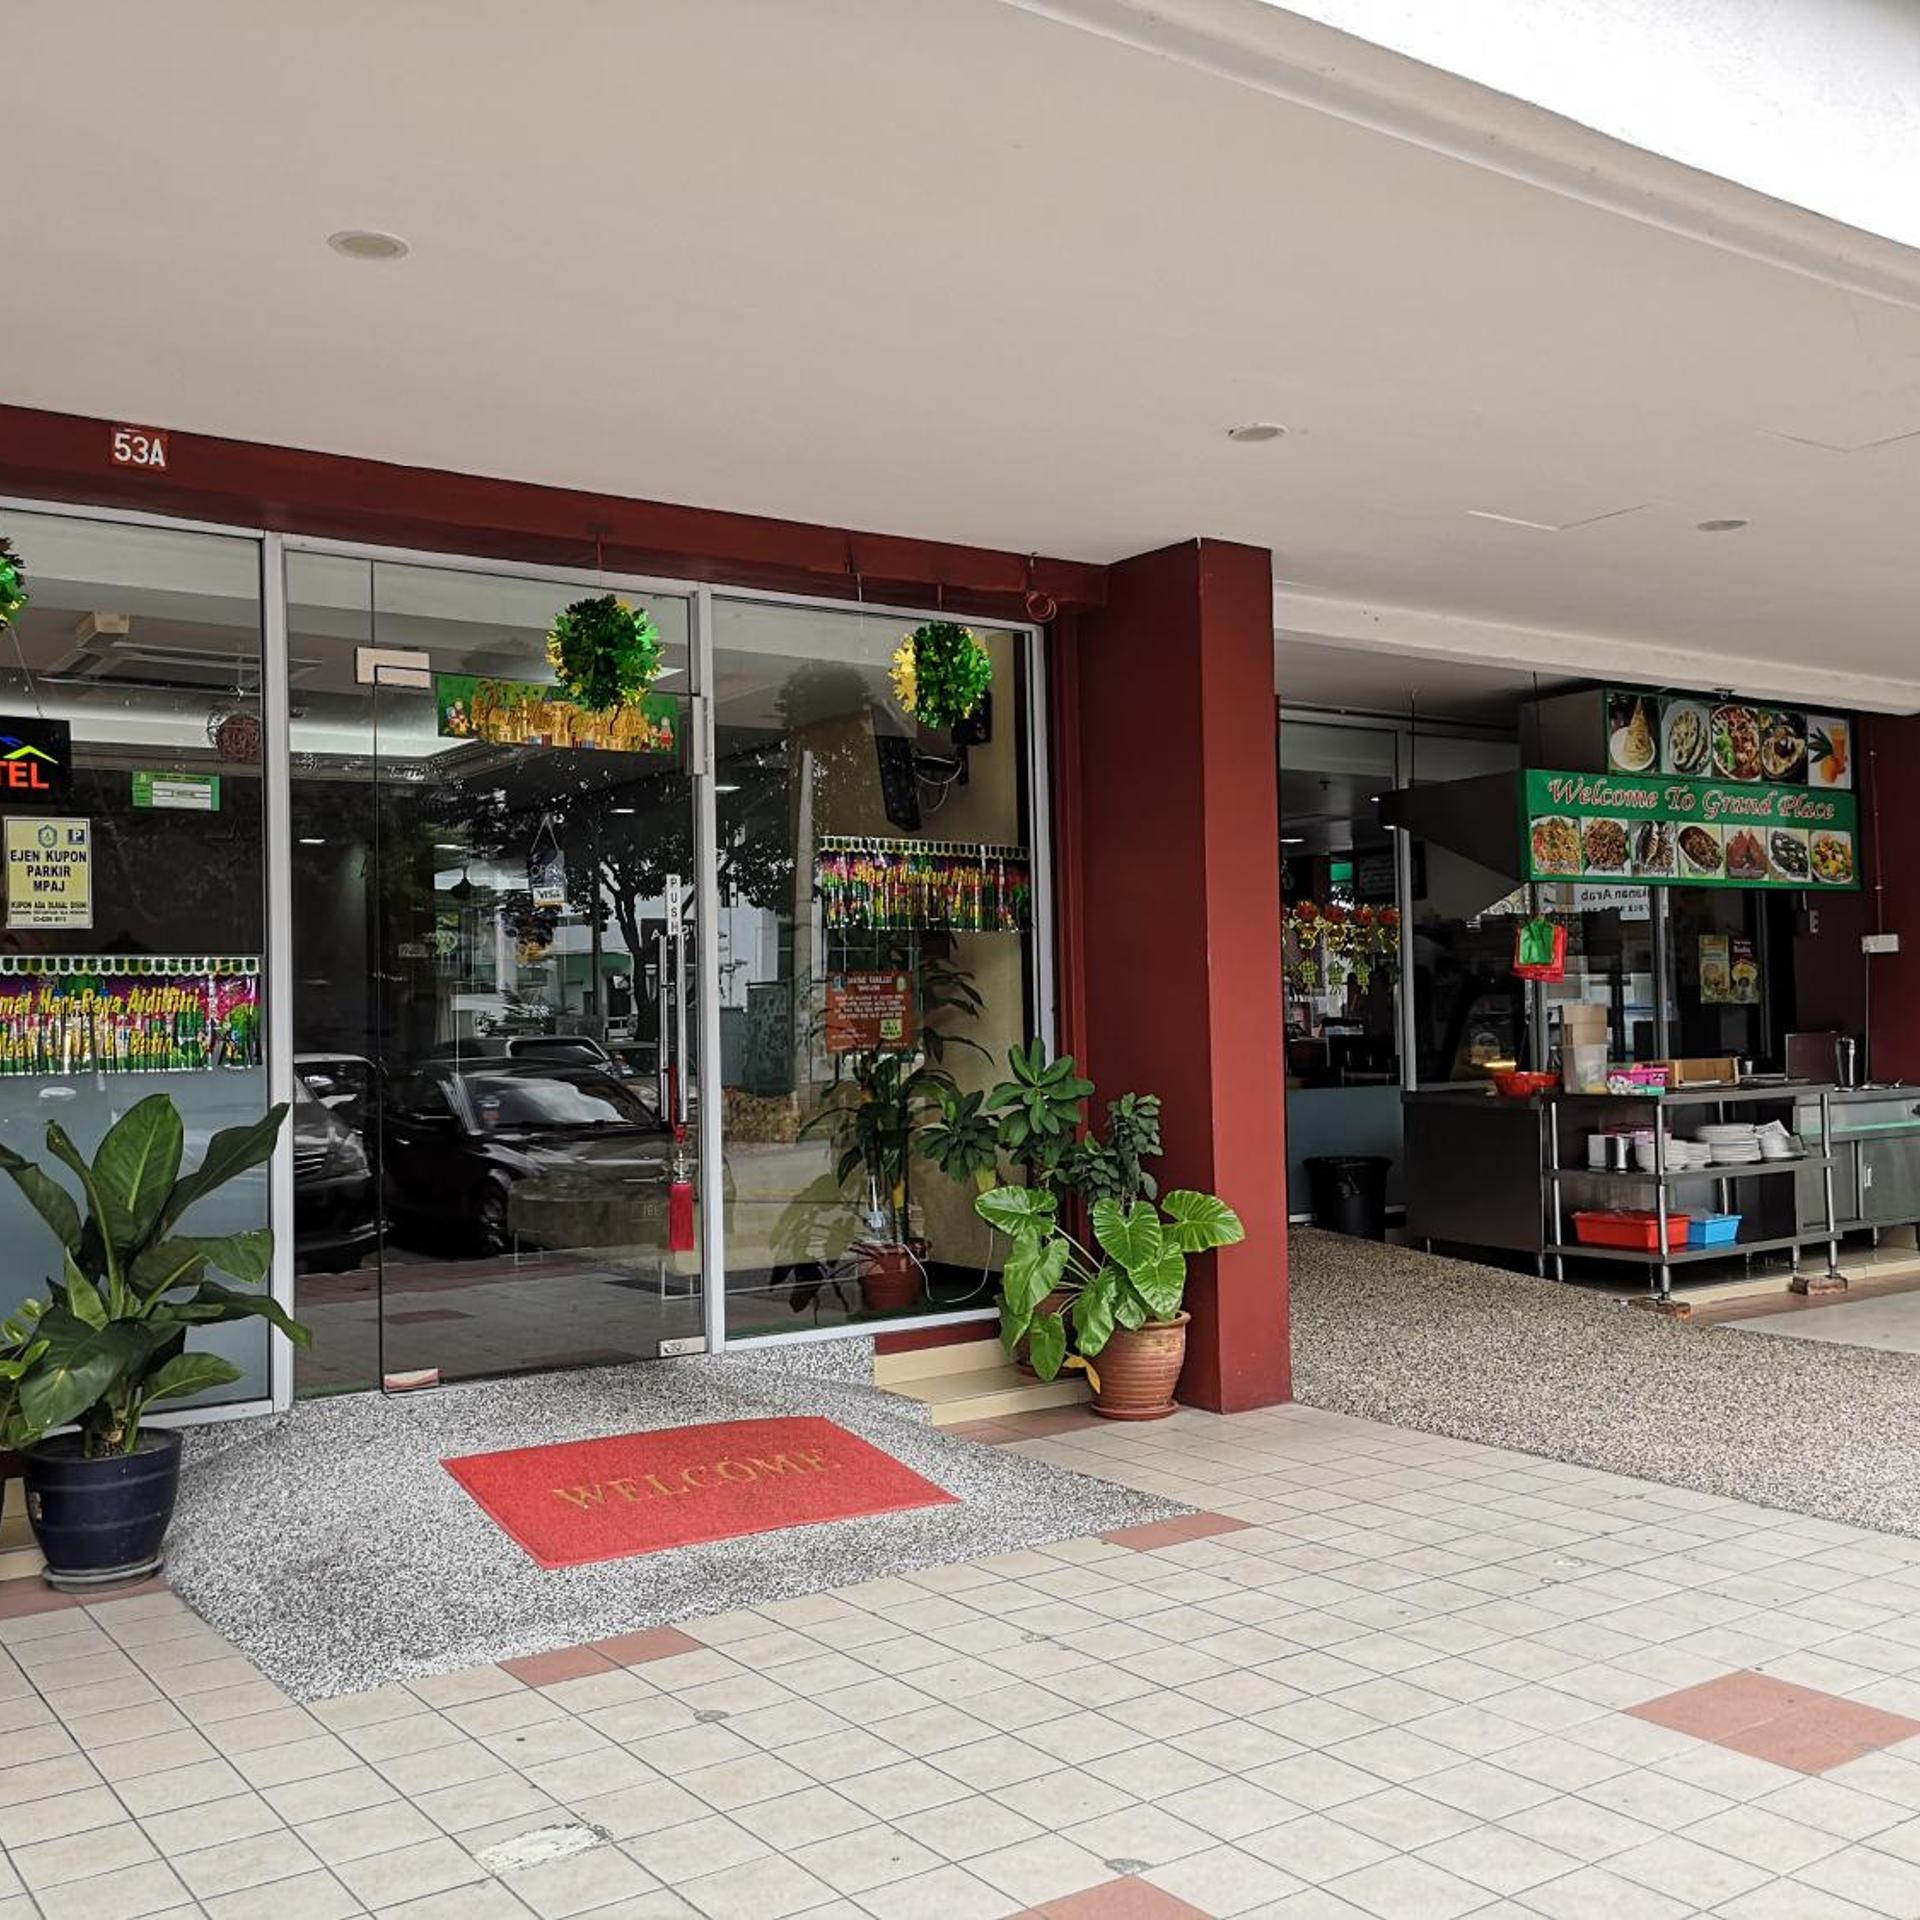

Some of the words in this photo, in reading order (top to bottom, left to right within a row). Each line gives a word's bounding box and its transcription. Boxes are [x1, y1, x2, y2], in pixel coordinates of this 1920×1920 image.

[114, 432, 166, 467] 53A
[1547, 777, 1658, 810] Welcome
[1664, 786, 1696, 812] To
[1702, 785, 1777, 820] Grand
[1777, 793, 1836, 820] Place
[10, 850, 40, 862] EJEN
[46, 851, 87, 863] KUPON
[27, 865, 71, 878] PARKIR
[33, 880, 65, 892] MPAJ
[670, 877, 679, 934] PUSH
[39, 986, 76, 1015] Hari
[82, 988, 121, 1018] Raya
[551, 1448, 842, 1512] WELCOME
